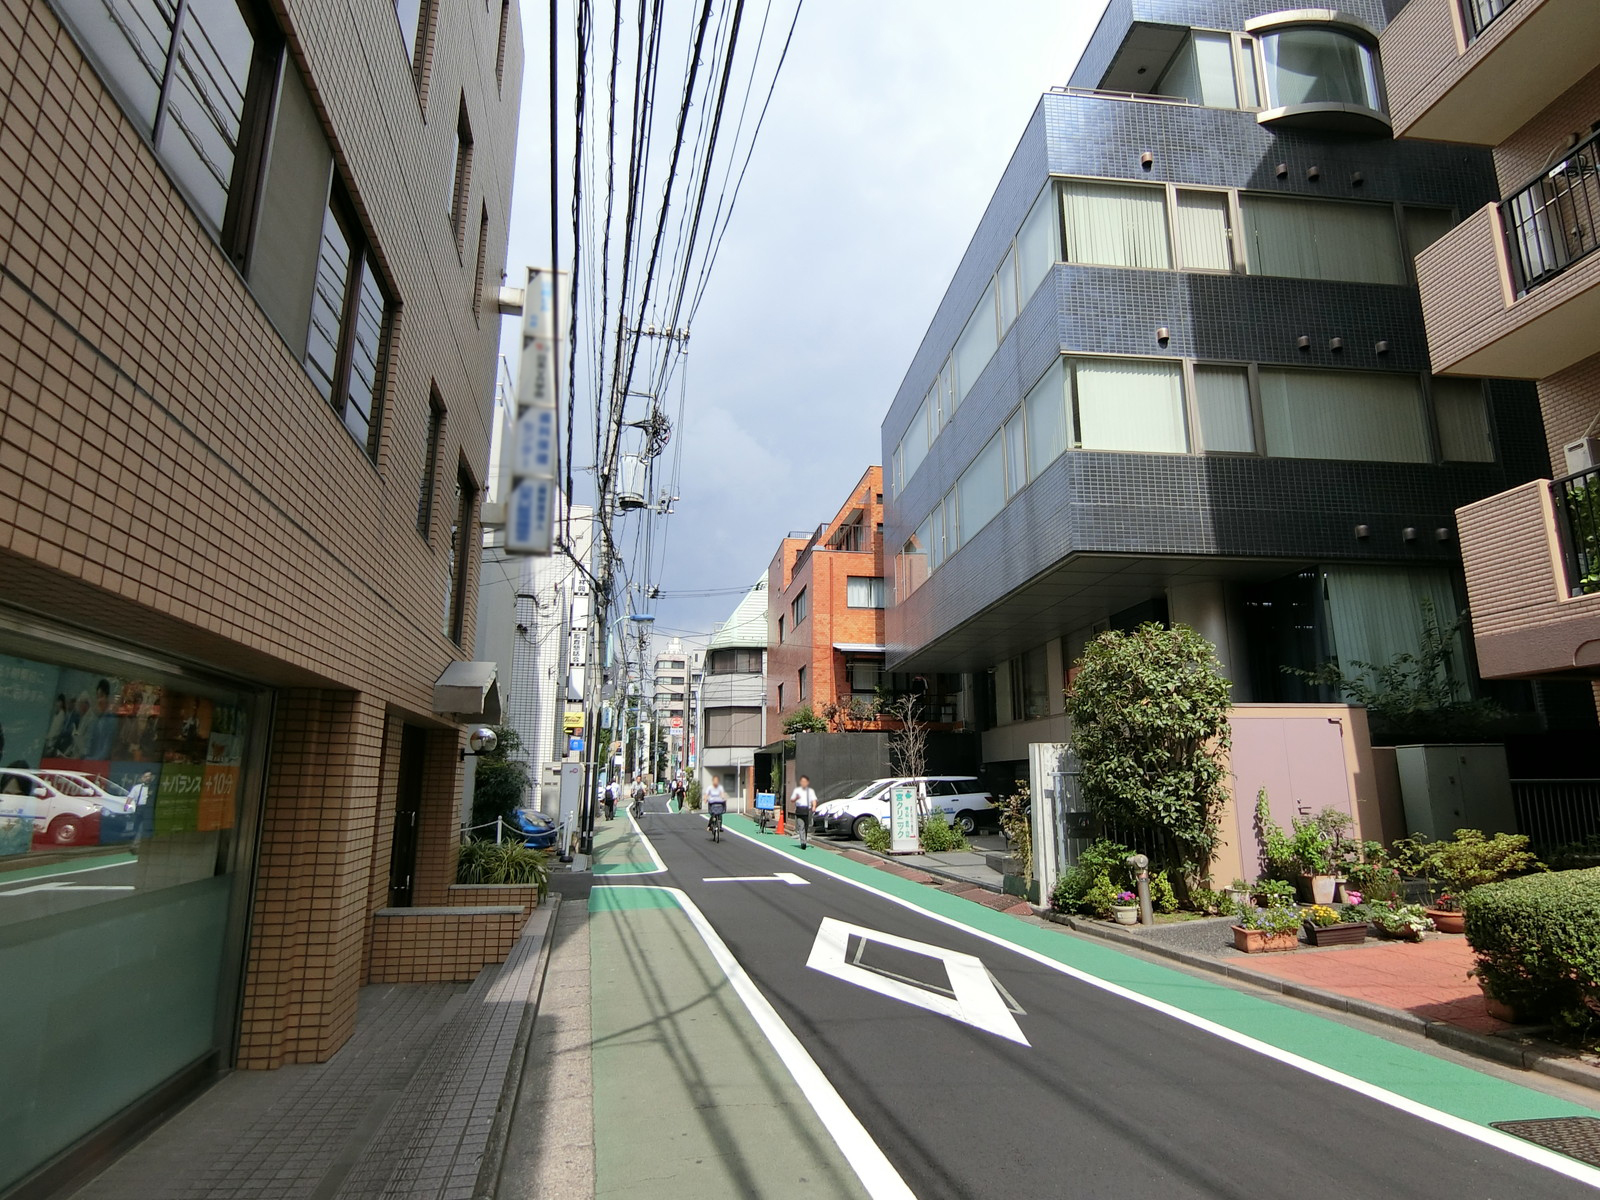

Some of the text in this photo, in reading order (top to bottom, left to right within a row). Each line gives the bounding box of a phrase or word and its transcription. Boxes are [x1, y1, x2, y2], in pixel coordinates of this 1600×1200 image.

[161, 773, 202, 794] +バランス
[205, 773, 233, 794] +10分
